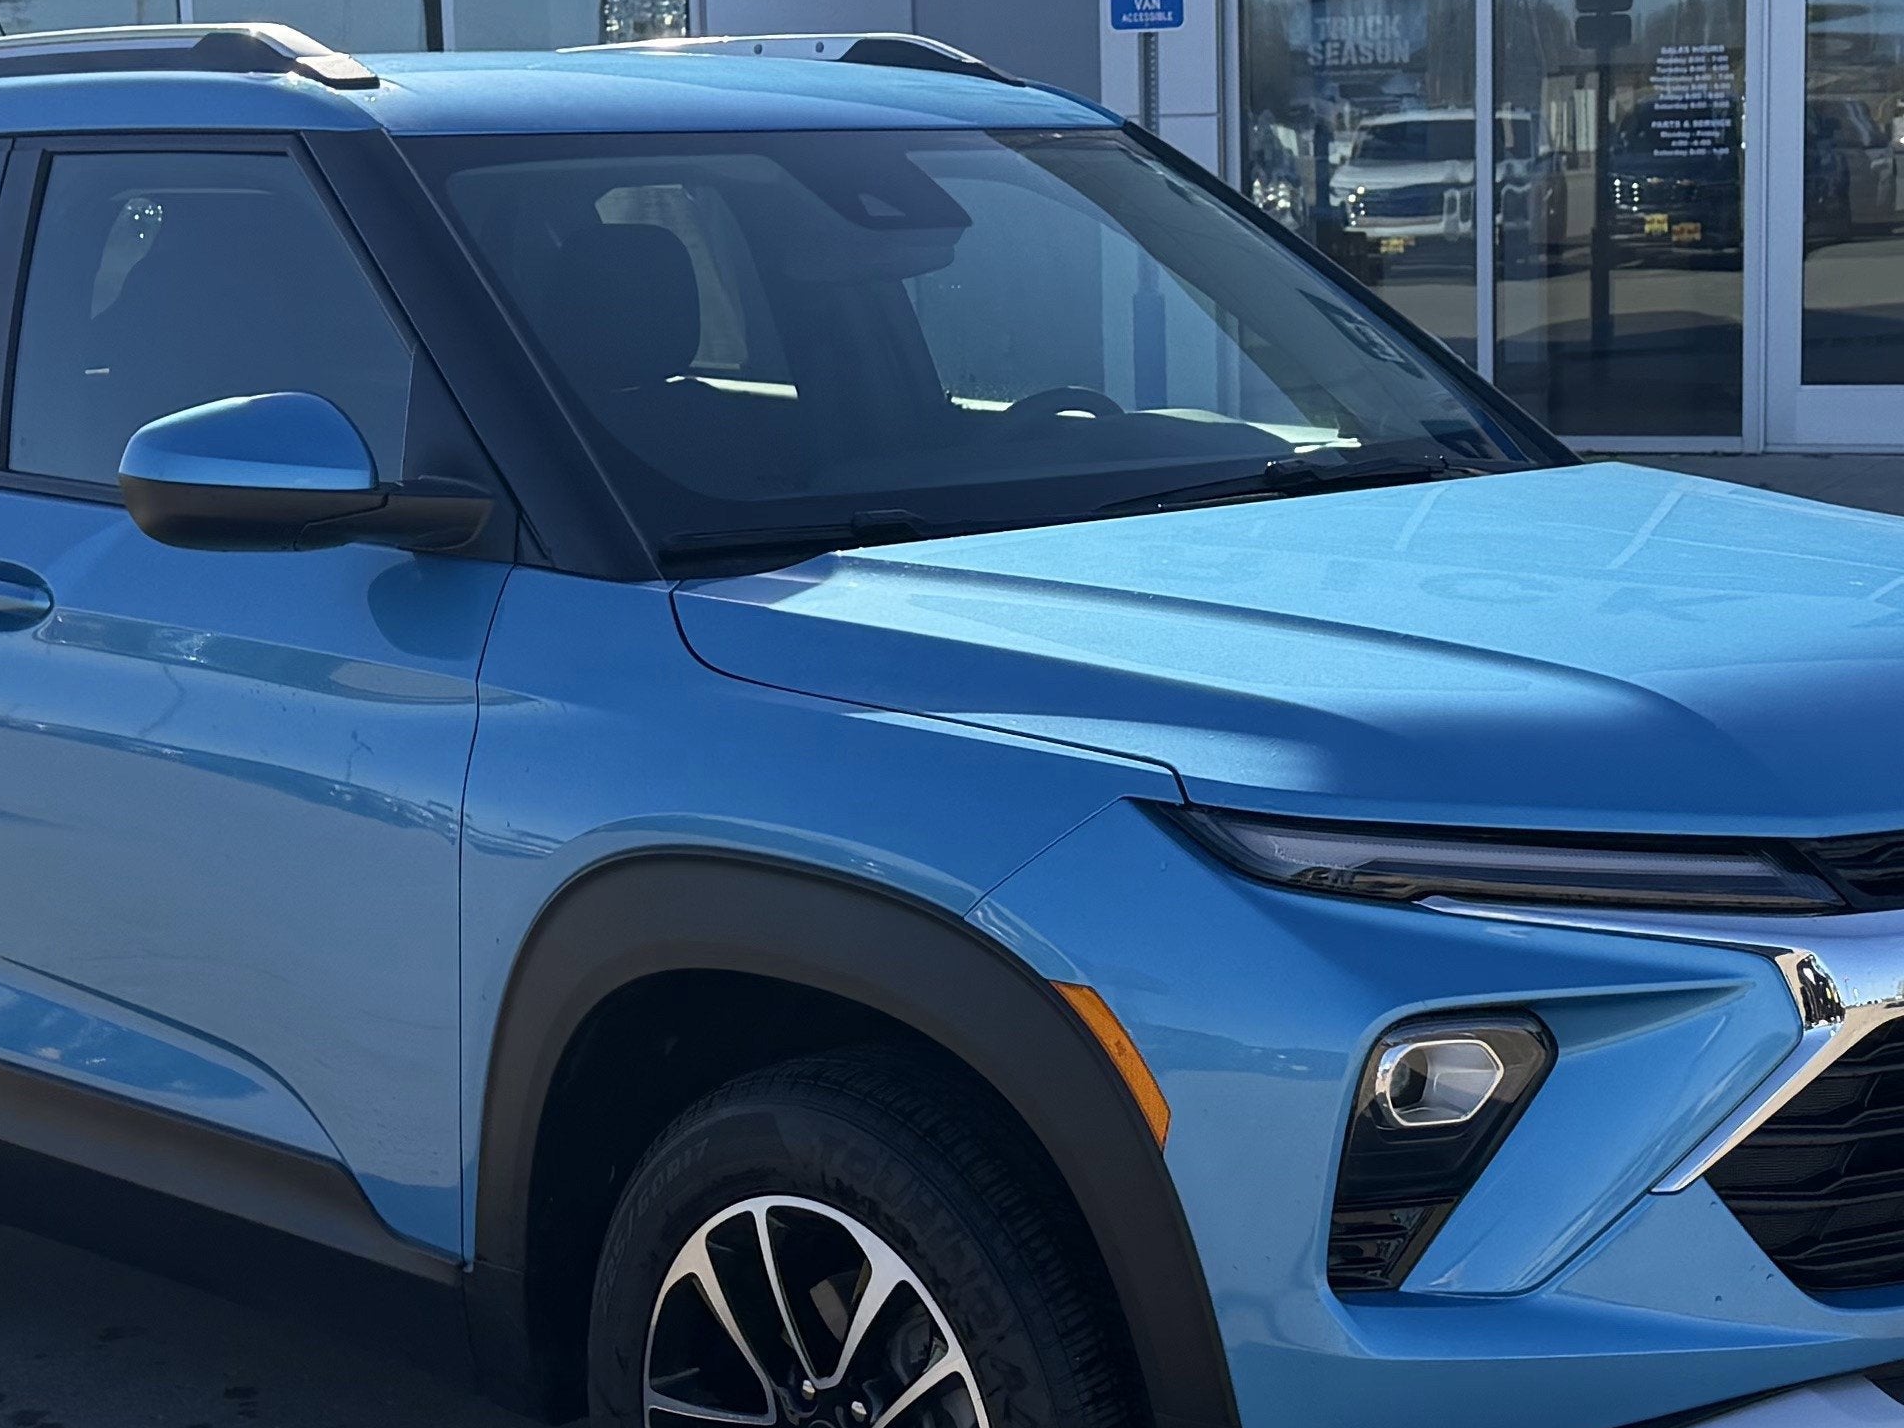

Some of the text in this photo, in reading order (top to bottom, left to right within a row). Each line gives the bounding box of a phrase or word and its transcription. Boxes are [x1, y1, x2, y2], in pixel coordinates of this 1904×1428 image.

[1122, 12, 1173, 22] ACCESSIBLE
[1314, 15, 1400, 40] TRUCK
[1307, 40, 1409, 65] SEASON
